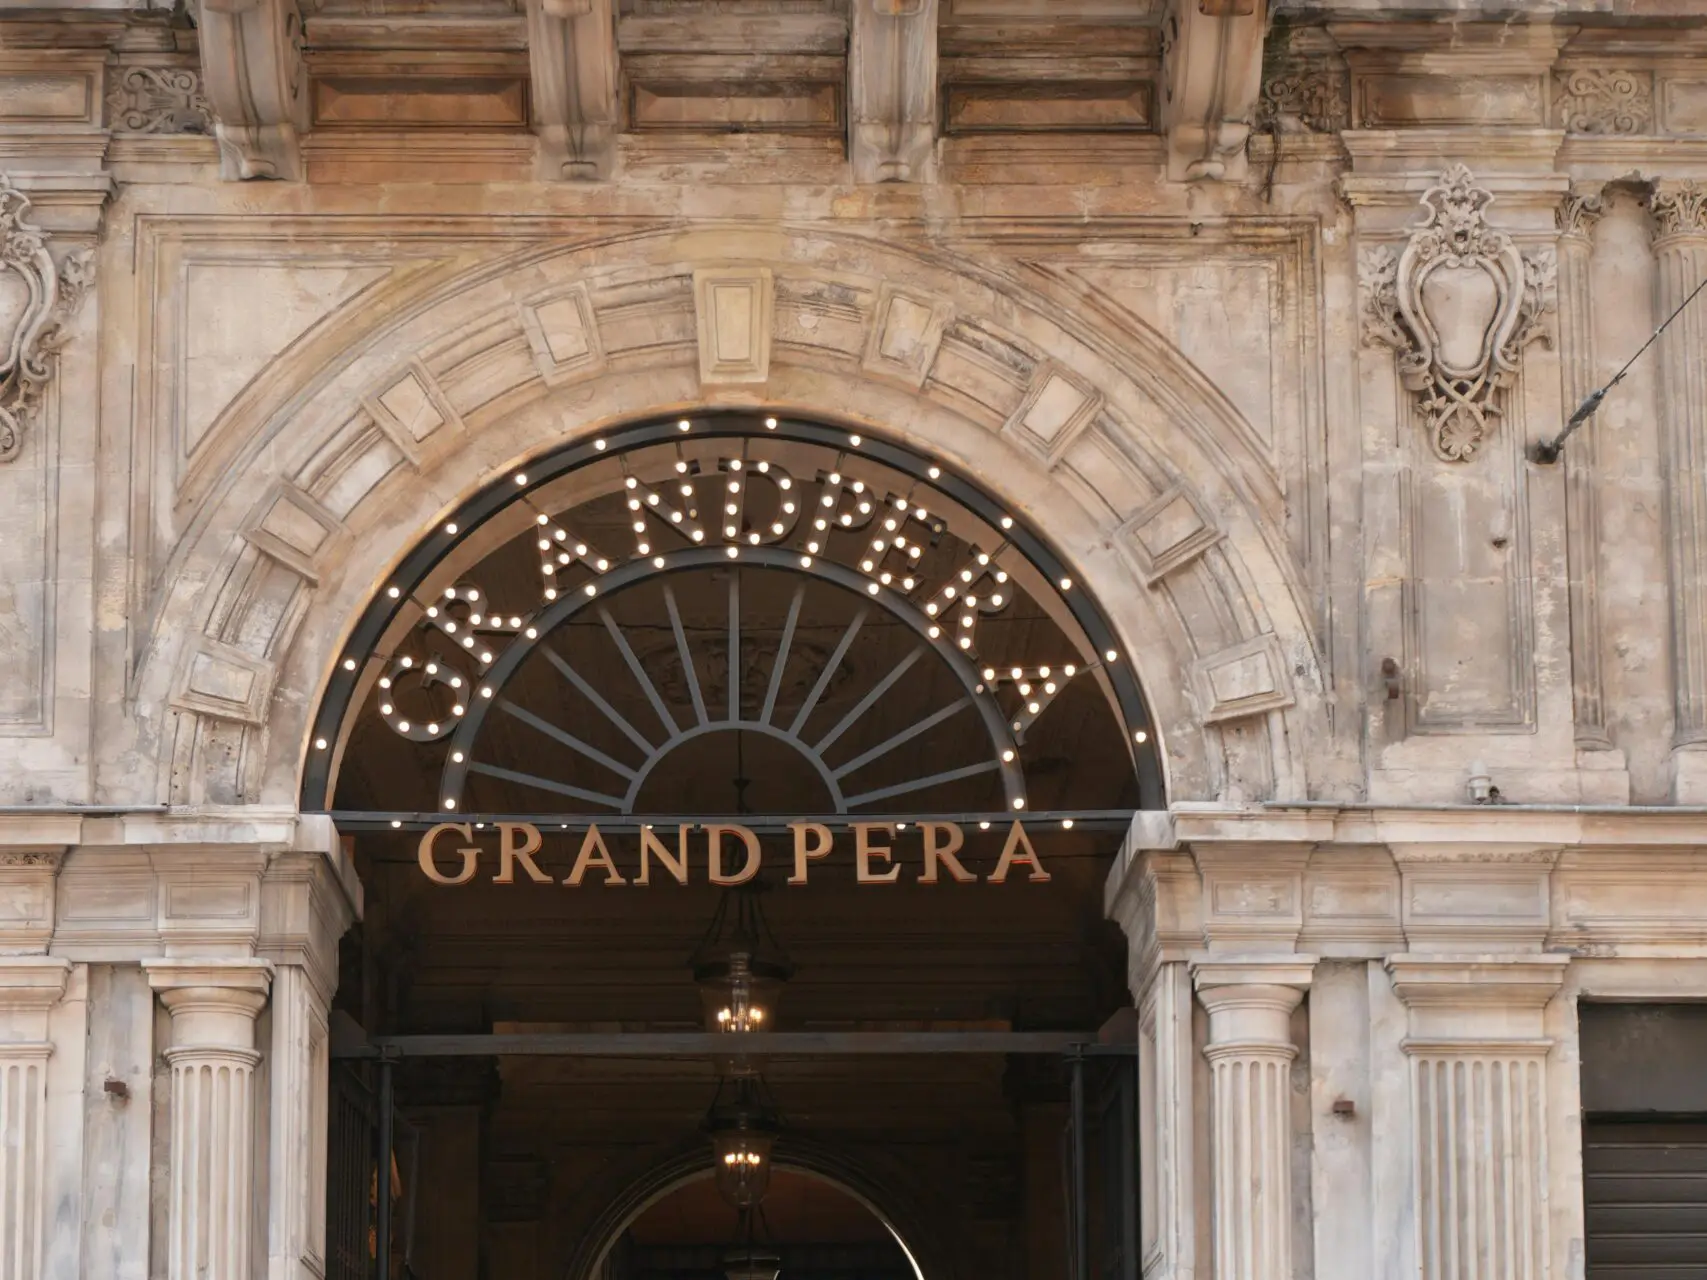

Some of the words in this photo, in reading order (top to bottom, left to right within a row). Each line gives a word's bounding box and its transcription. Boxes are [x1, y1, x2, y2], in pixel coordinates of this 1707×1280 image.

[377, 457, 799, 743] GRAND
[806, 468, 1078, 746] PERA
[417, 821, 762, 887] GRAND
[787, 819, 1052, 885] PERA
